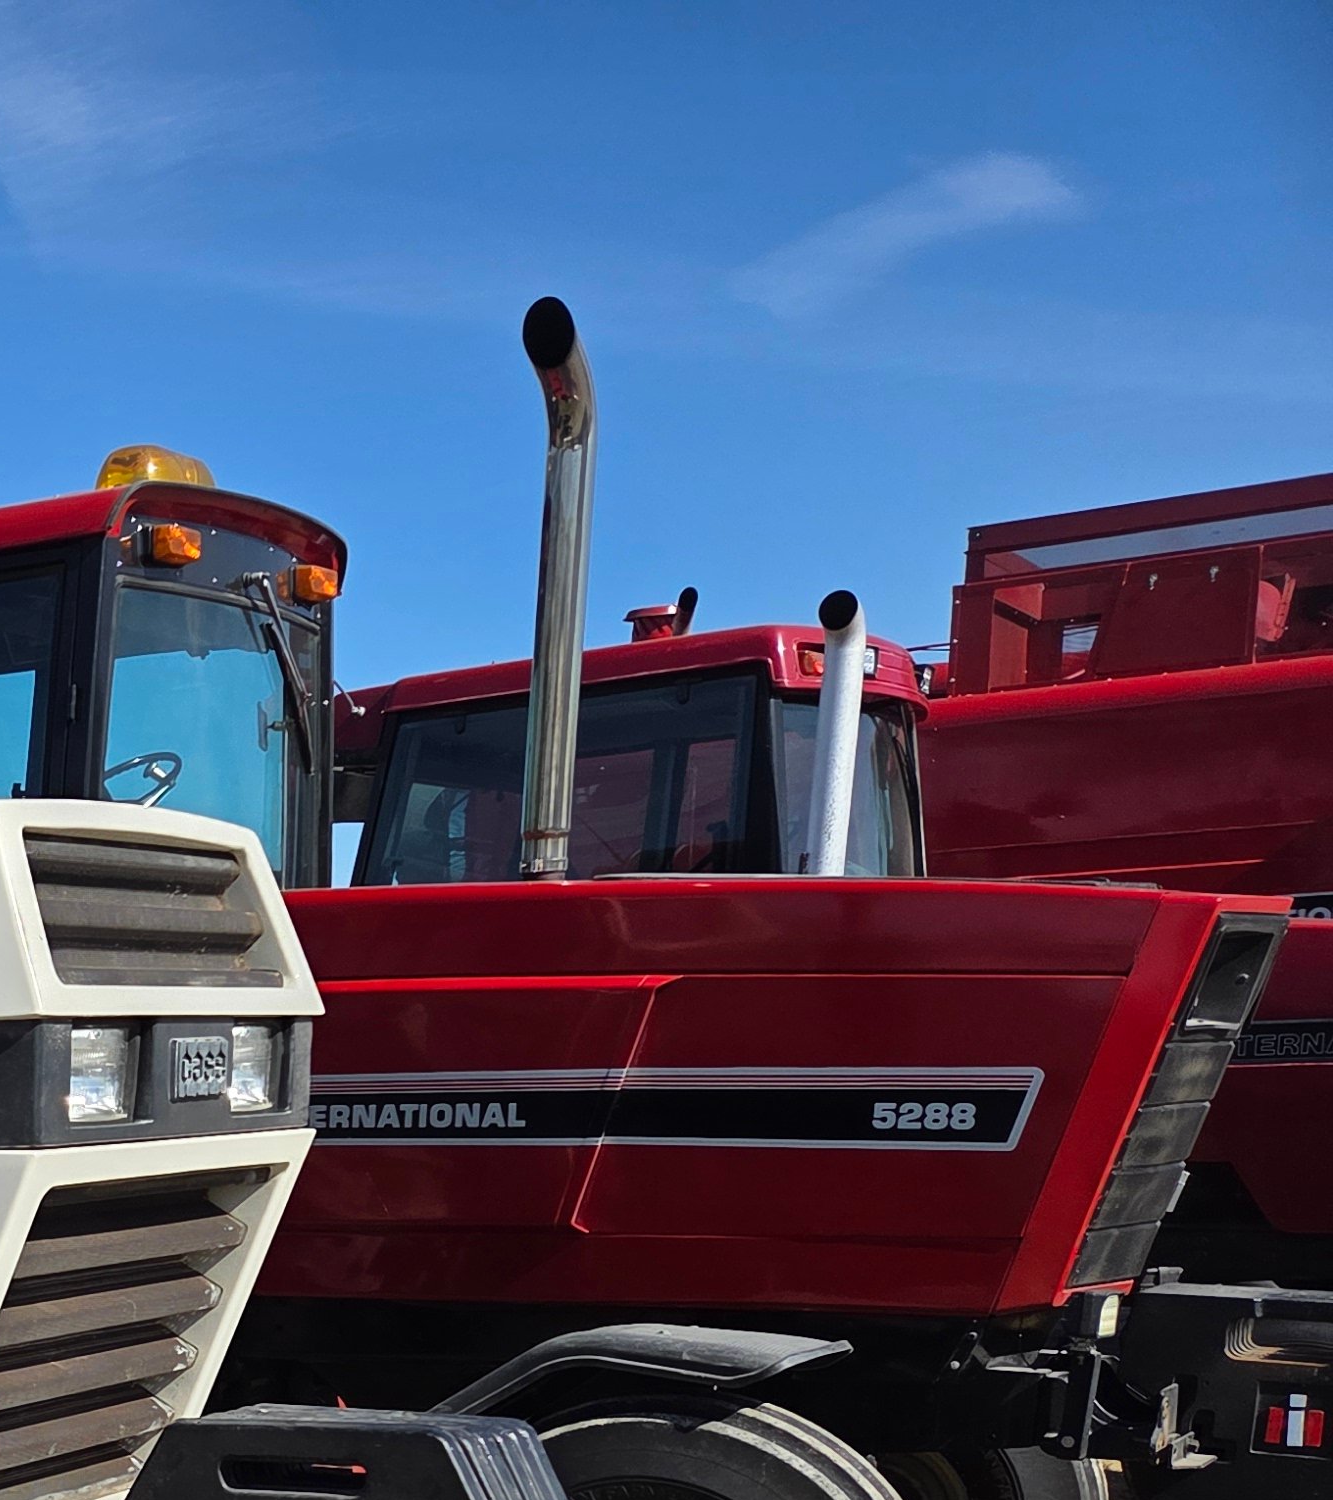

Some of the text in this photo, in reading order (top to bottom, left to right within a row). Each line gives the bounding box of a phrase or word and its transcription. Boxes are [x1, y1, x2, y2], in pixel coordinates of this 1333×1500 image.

[1236, 1031, 1333, 1057] TERN
[309, 1103, 526, 1128] ERNATIONAL
[872, 1102, 976, 1130] 5288
